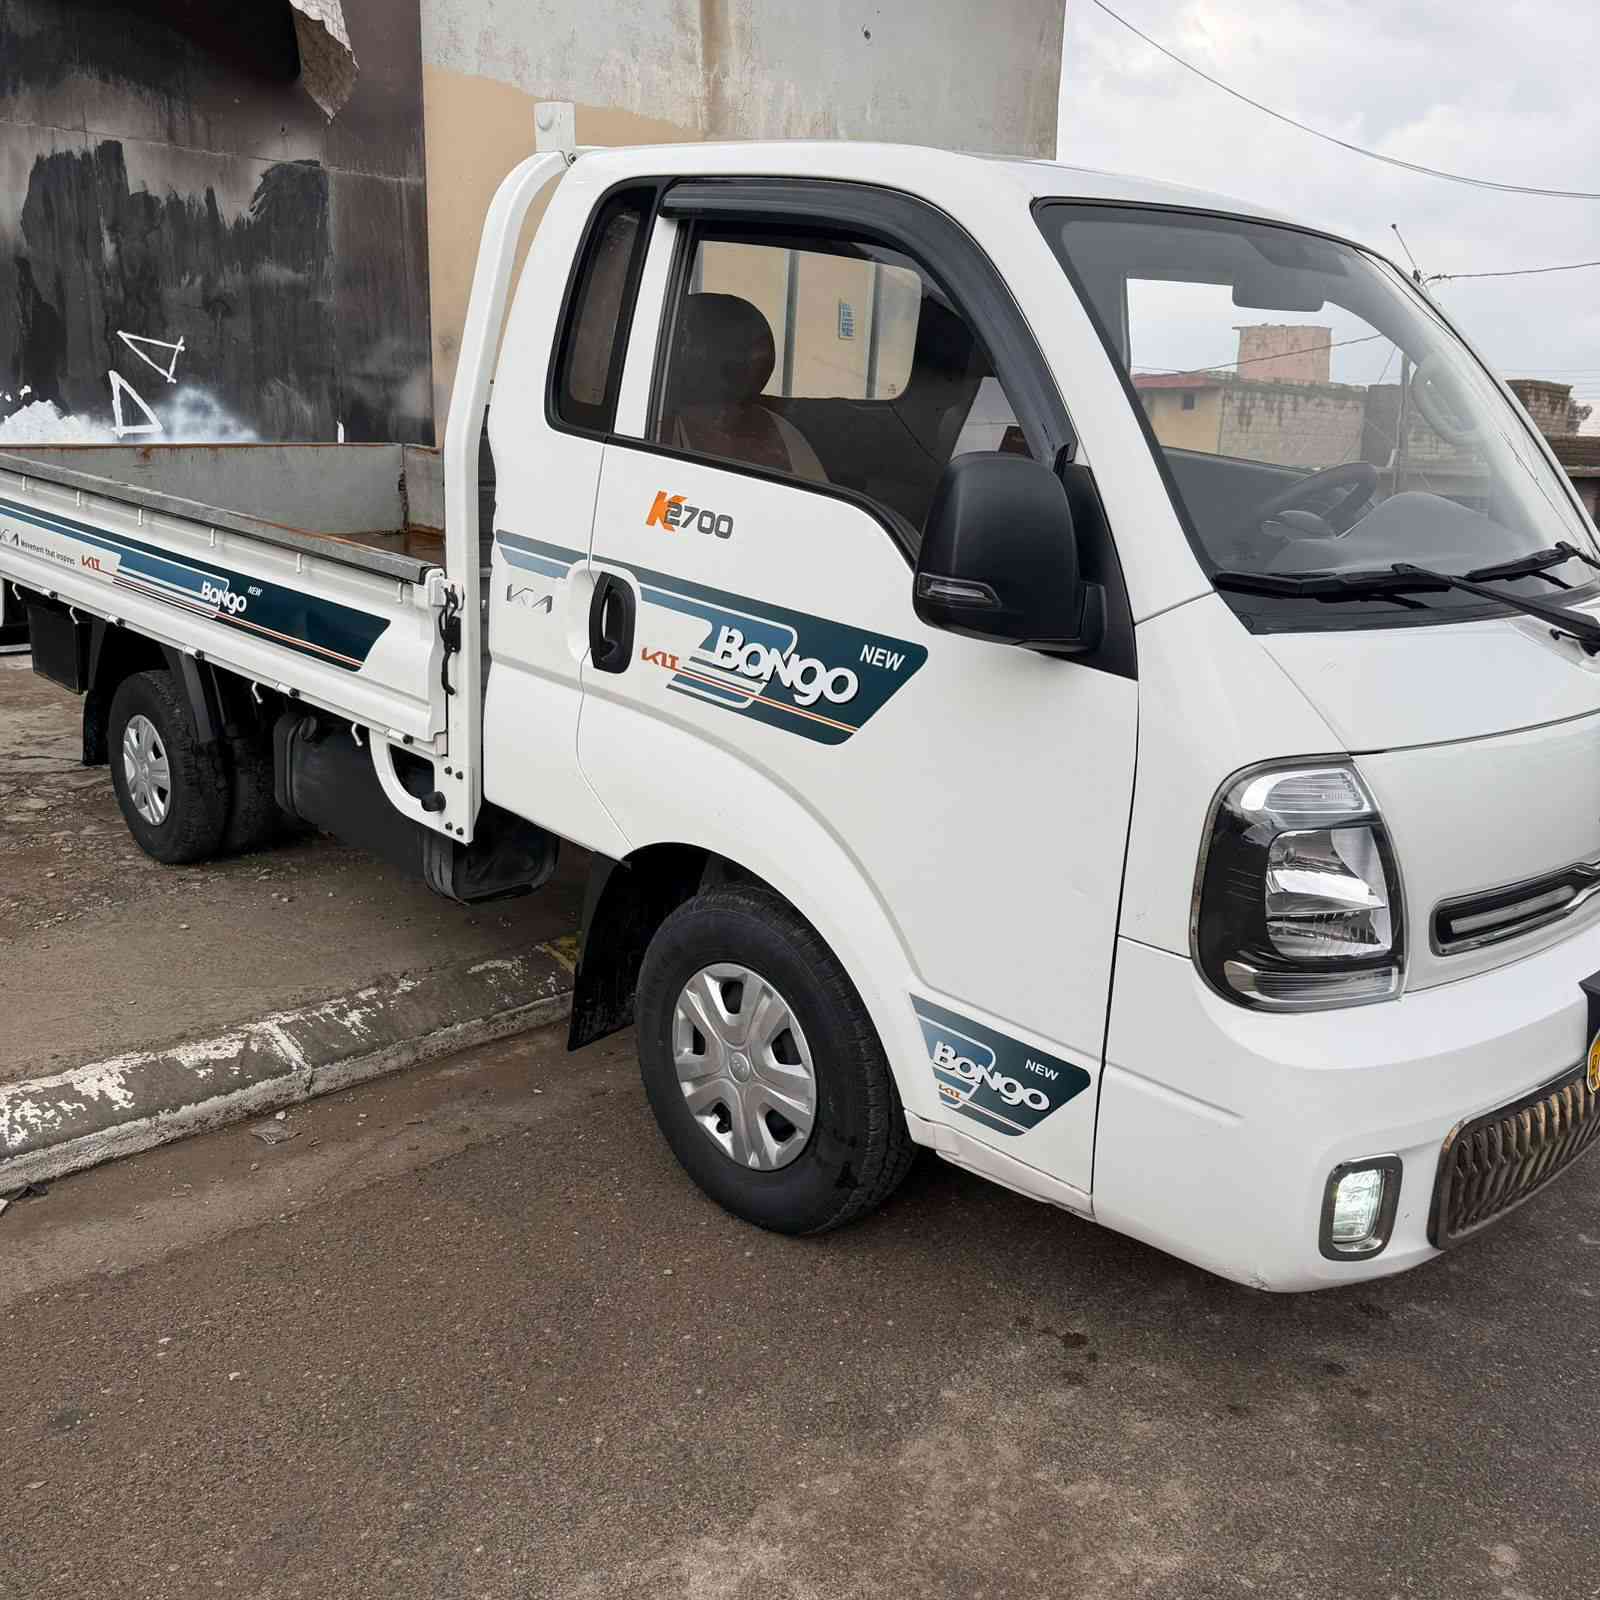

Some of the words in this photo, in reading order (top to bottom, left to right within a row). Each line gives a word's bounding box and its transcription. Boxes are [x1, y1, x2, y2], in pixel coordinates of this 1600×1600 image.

[646, 490, 734, 539] K2700
[247, 585, 263, 597] NEW
[859, 643, 906, 673] NEW
[1024, 1058, 1059, 1081] NEW
